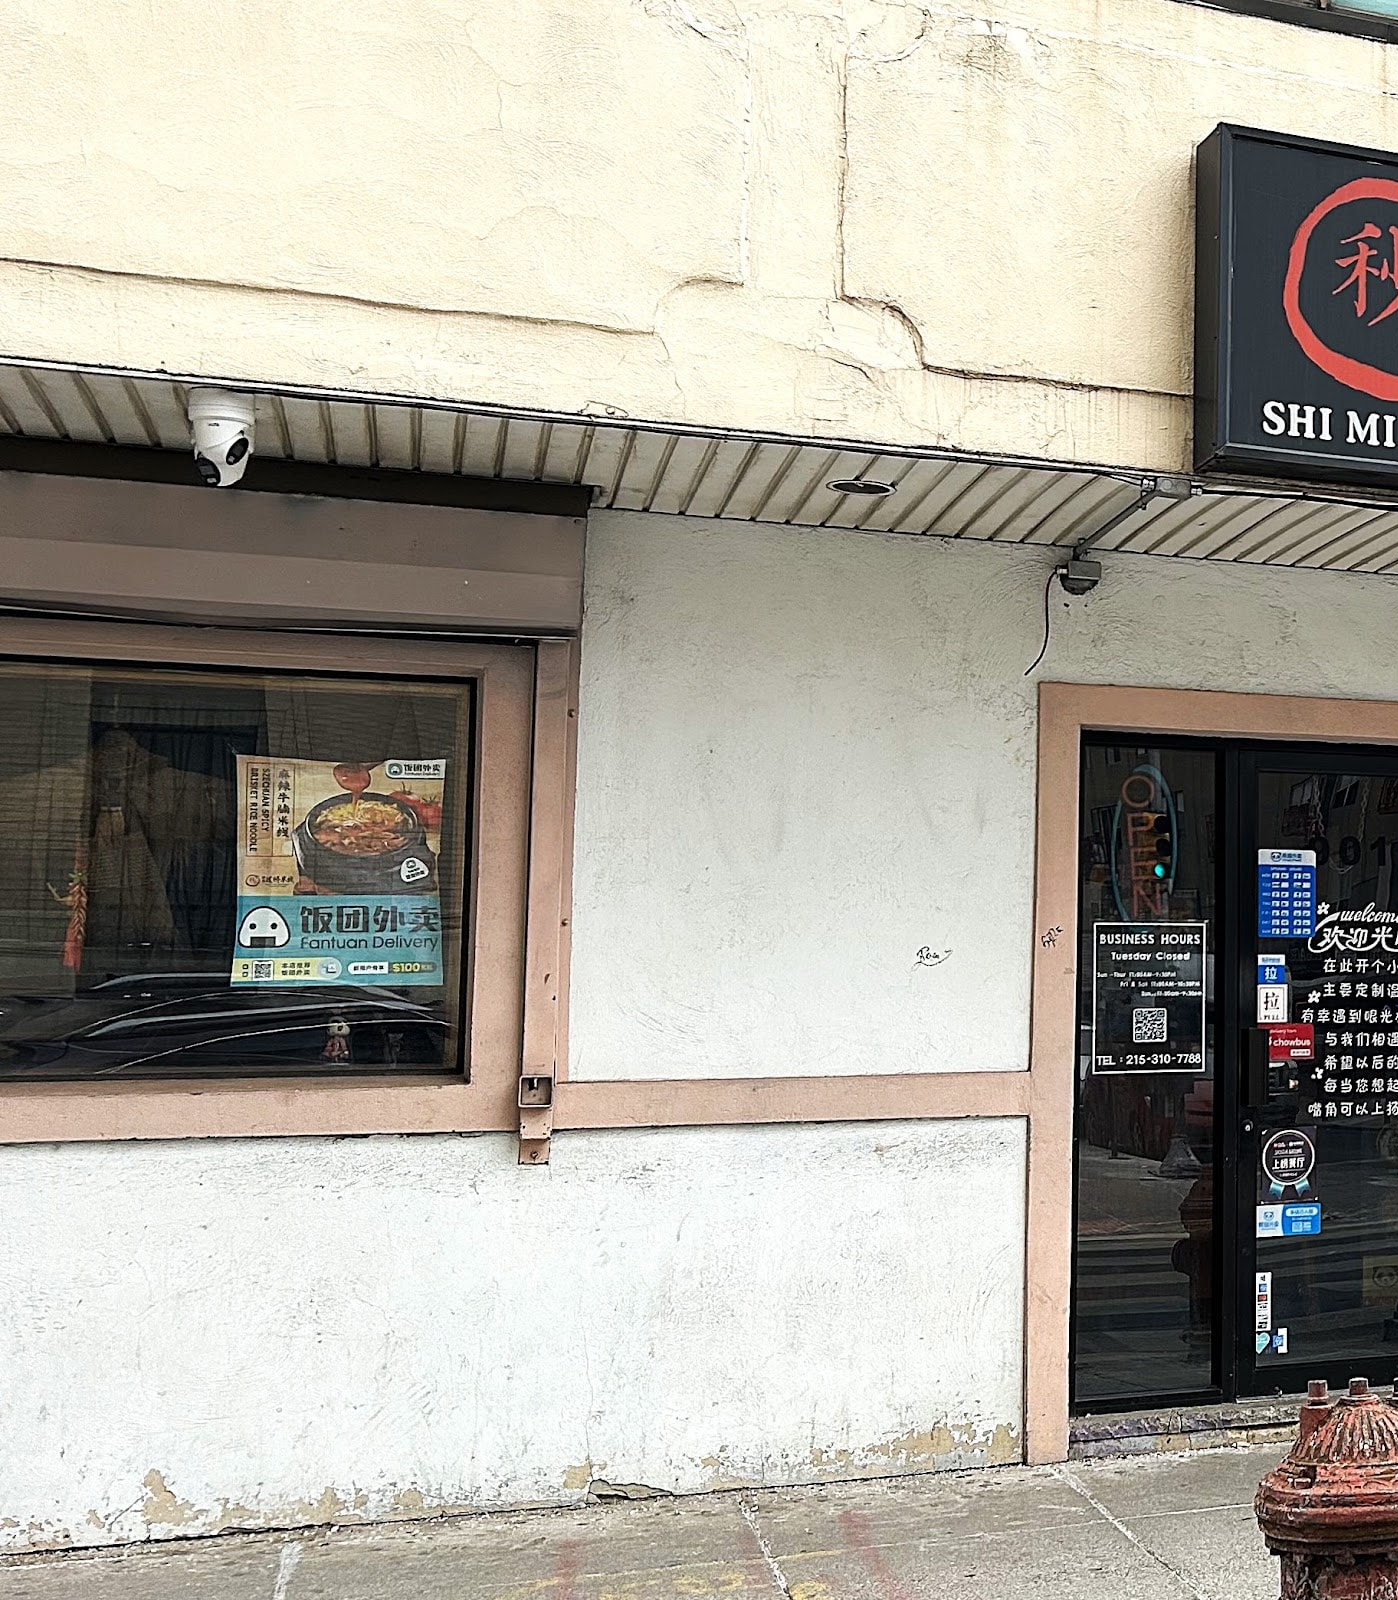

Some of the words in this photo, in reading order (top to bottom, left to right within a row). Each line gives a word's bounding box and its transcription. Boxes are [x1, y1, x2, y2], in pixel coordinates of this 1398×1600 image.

[1262, 401, 1333, 440] SHI
[249, 802, 258, 820] RICE
[300, 905, 439, 934] 饭团外卖
[300, 936, 368, 949] Fantuan
[372, 935, 438, 952] Delivery
[1099, 933, 1155, 945] BUSINESS
[1160, 933, 1201, 945] HOURS
[1111, 952, 1151, 961] Tuesday
[1156, 952, 1191, 961] Closed
[1265, 967, 1278, 980] 拉
[1264, 992, 1280, 1010] 拉
[1273, 1038, 1311, 1046] chowbus
[1126, 1053, 1202, 1065] 215-310-7788
